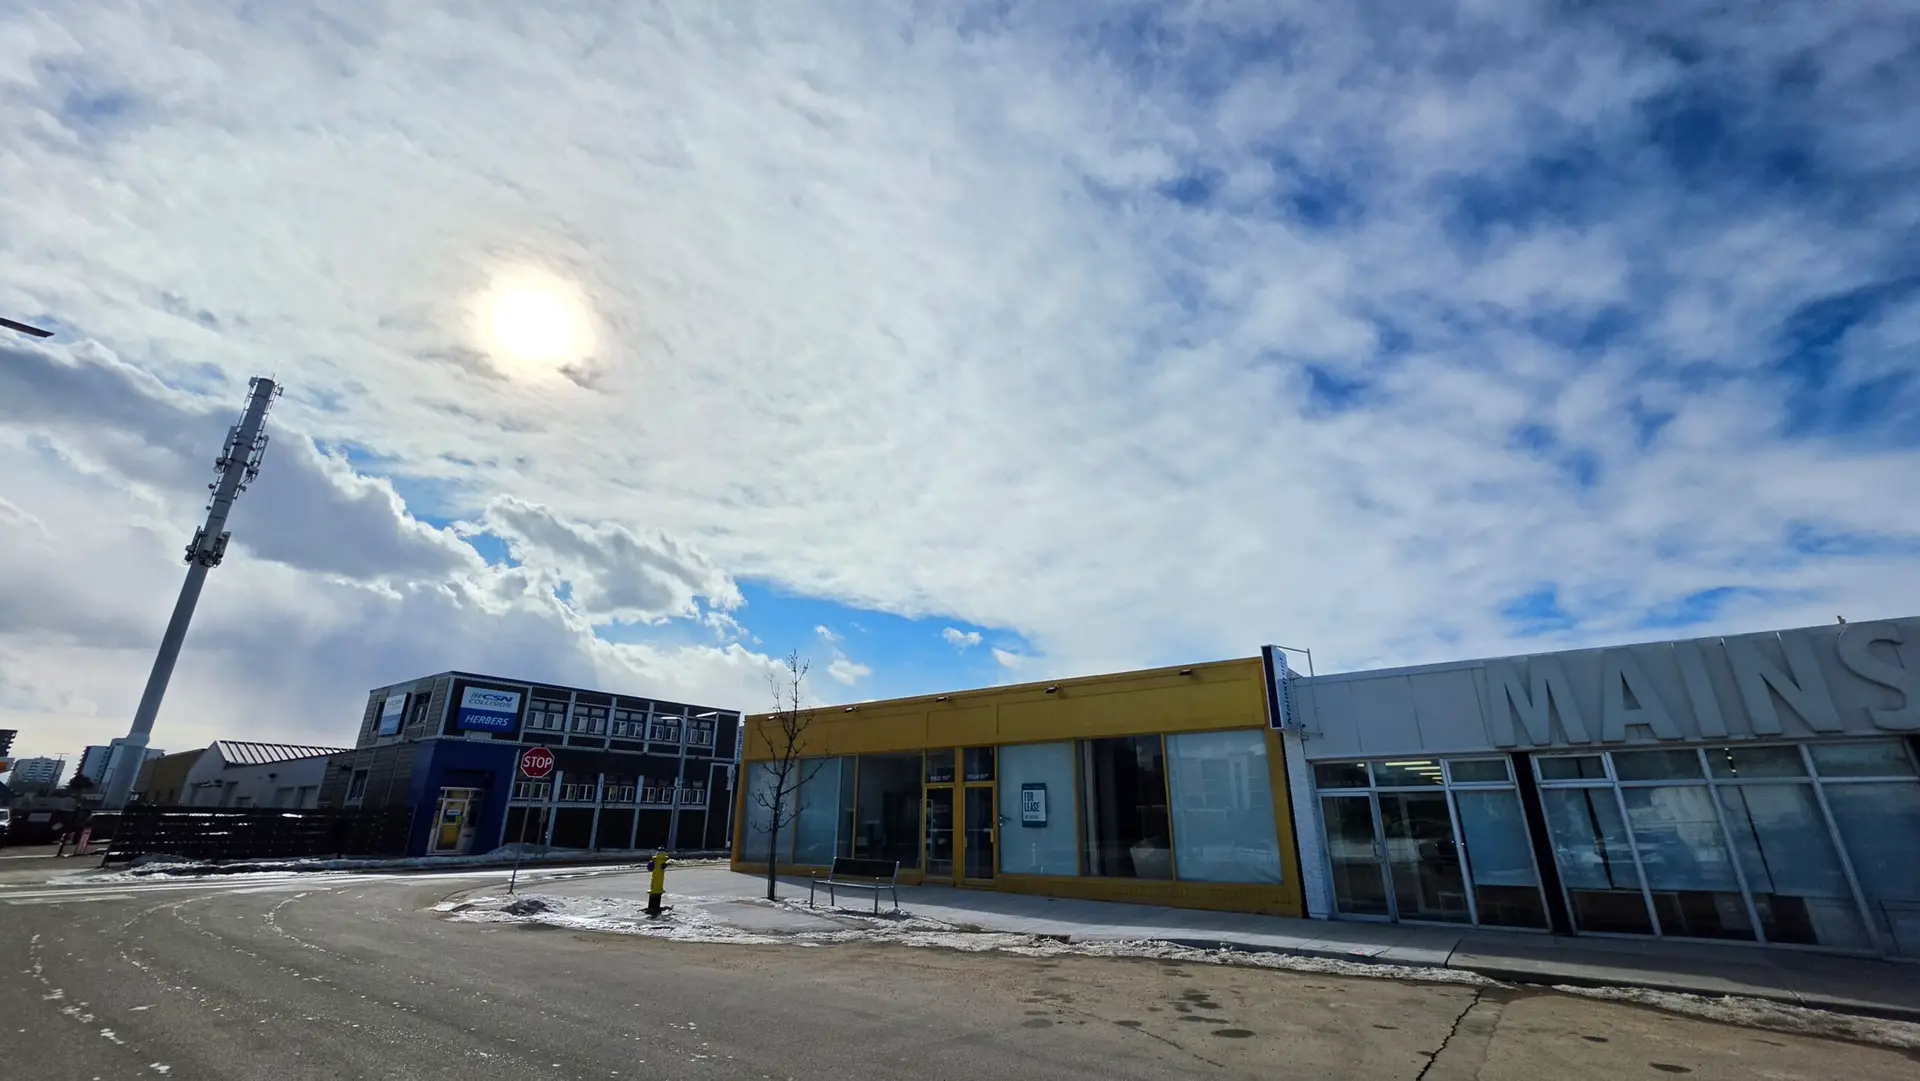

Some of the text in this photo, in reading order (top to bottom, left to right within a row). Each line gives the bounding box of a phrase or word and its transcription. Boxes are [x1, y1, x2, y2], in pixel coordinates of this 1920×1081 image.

[1484, 622, 1920, 747] MAINS
[482, 693, 513, 702] CSN
[468, 698, 513, 709] COLLISION
[464, 713, 509, 727] HERBERS
[523, 755, 552, 769] STOP
[1024, 791, 1034, 802] FOR
[1024, 801, 1040, 812] LEASE
